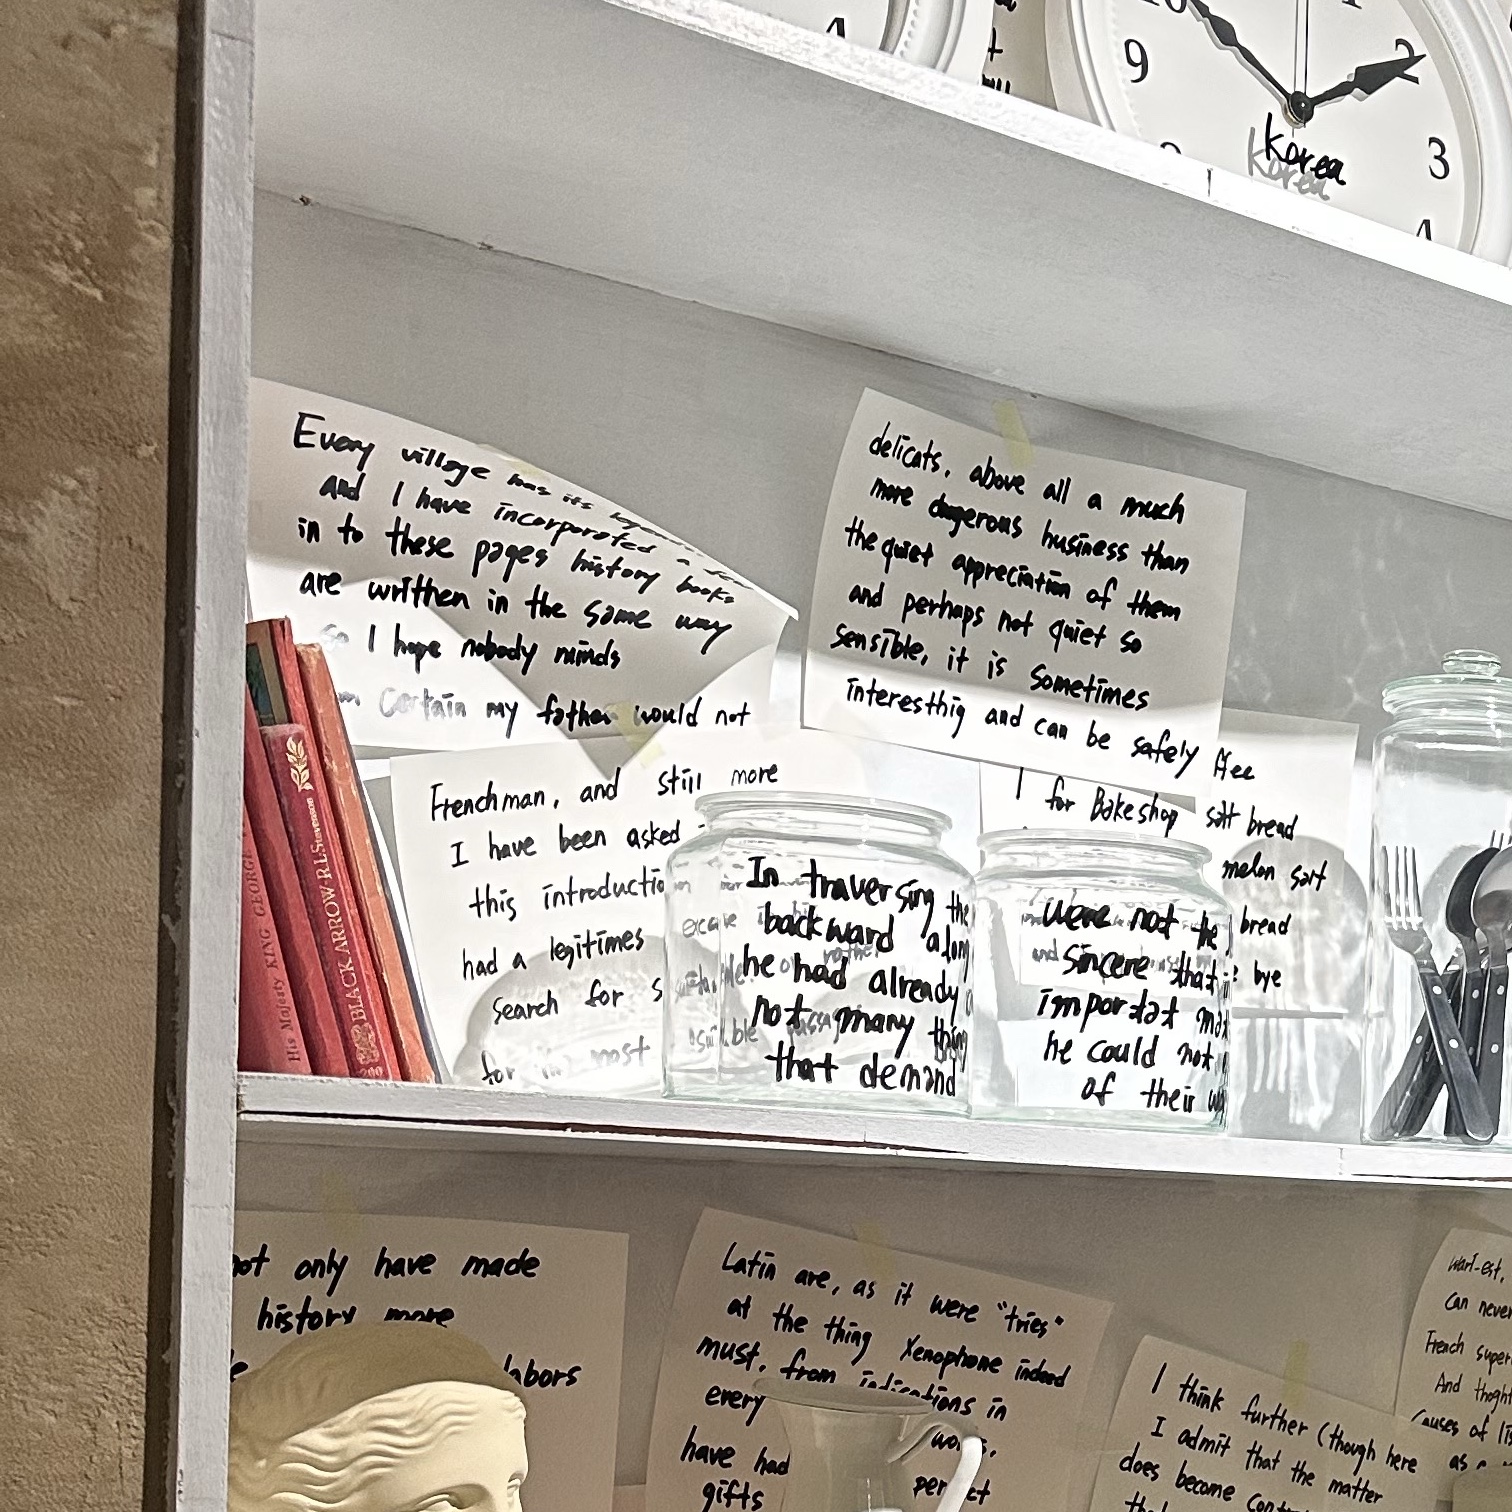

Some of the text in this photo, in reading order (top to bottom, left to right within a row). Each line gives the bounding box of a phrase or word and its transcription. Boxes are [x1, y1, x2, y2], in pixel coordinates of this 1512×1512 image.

[1124, 39, 1148, 83] 9
[1429, 137, 1449, 179] 3
[294, 412, 375, 472] Every
[319, 473, 366, 501] and
[416, 487, 471, 514] have
[969, 456, 1025, 495] above
[1043, 477, 1071, 504] all
[1088, 493, 1101, 510] a
[1120, 492, 1184, 524] much
[298, 517, 319, 543] in
[337, 512, 363, 545] to
[385, 516, 454, 558] these
[472, 540, 548, 583] pages
[571, 545, 660, 594] history
[676, 569, 734, 603] books
[849, 582, 885, 608] and
[901, 589, 985, 638] perhaps
[998, 610, 1033, 637] not
[1049, 619, 1106, 653] quiet
[394, 623, 441, 674] hope
[948, 646, 969, 673] it
[988, 650, 1007, 679] is
[580, 767, 621, 802] and
[732, 764, 777, 785] more
[1045, 776, 1178, 838] for Bakeshop
[489, 831, 536, 861] have
[559, 823, 606, 853] been
[627, 820, 680, 849] asked
[1240, 905, 1291, 935] bread
[318, 885, 367, 1021] BLACK ARROW
[743, 943, 959, 1026] he had already
[764, 1047, 837, 1083] that
[1044, 1030, 1072, 1065] he
[1177, 1041, 1214, 1071] not
[294, 1246, 540, 1297] only have made
[722, 1242, 776, 1281] Latin
[853, 1280, 875, 1299] as
[895, 1282, 913, 1306] it
[930, 1295, 979, 1323] were
[1179, 1373, 1224, 1412] think
[1241, 1394, 1308, 1436] further
